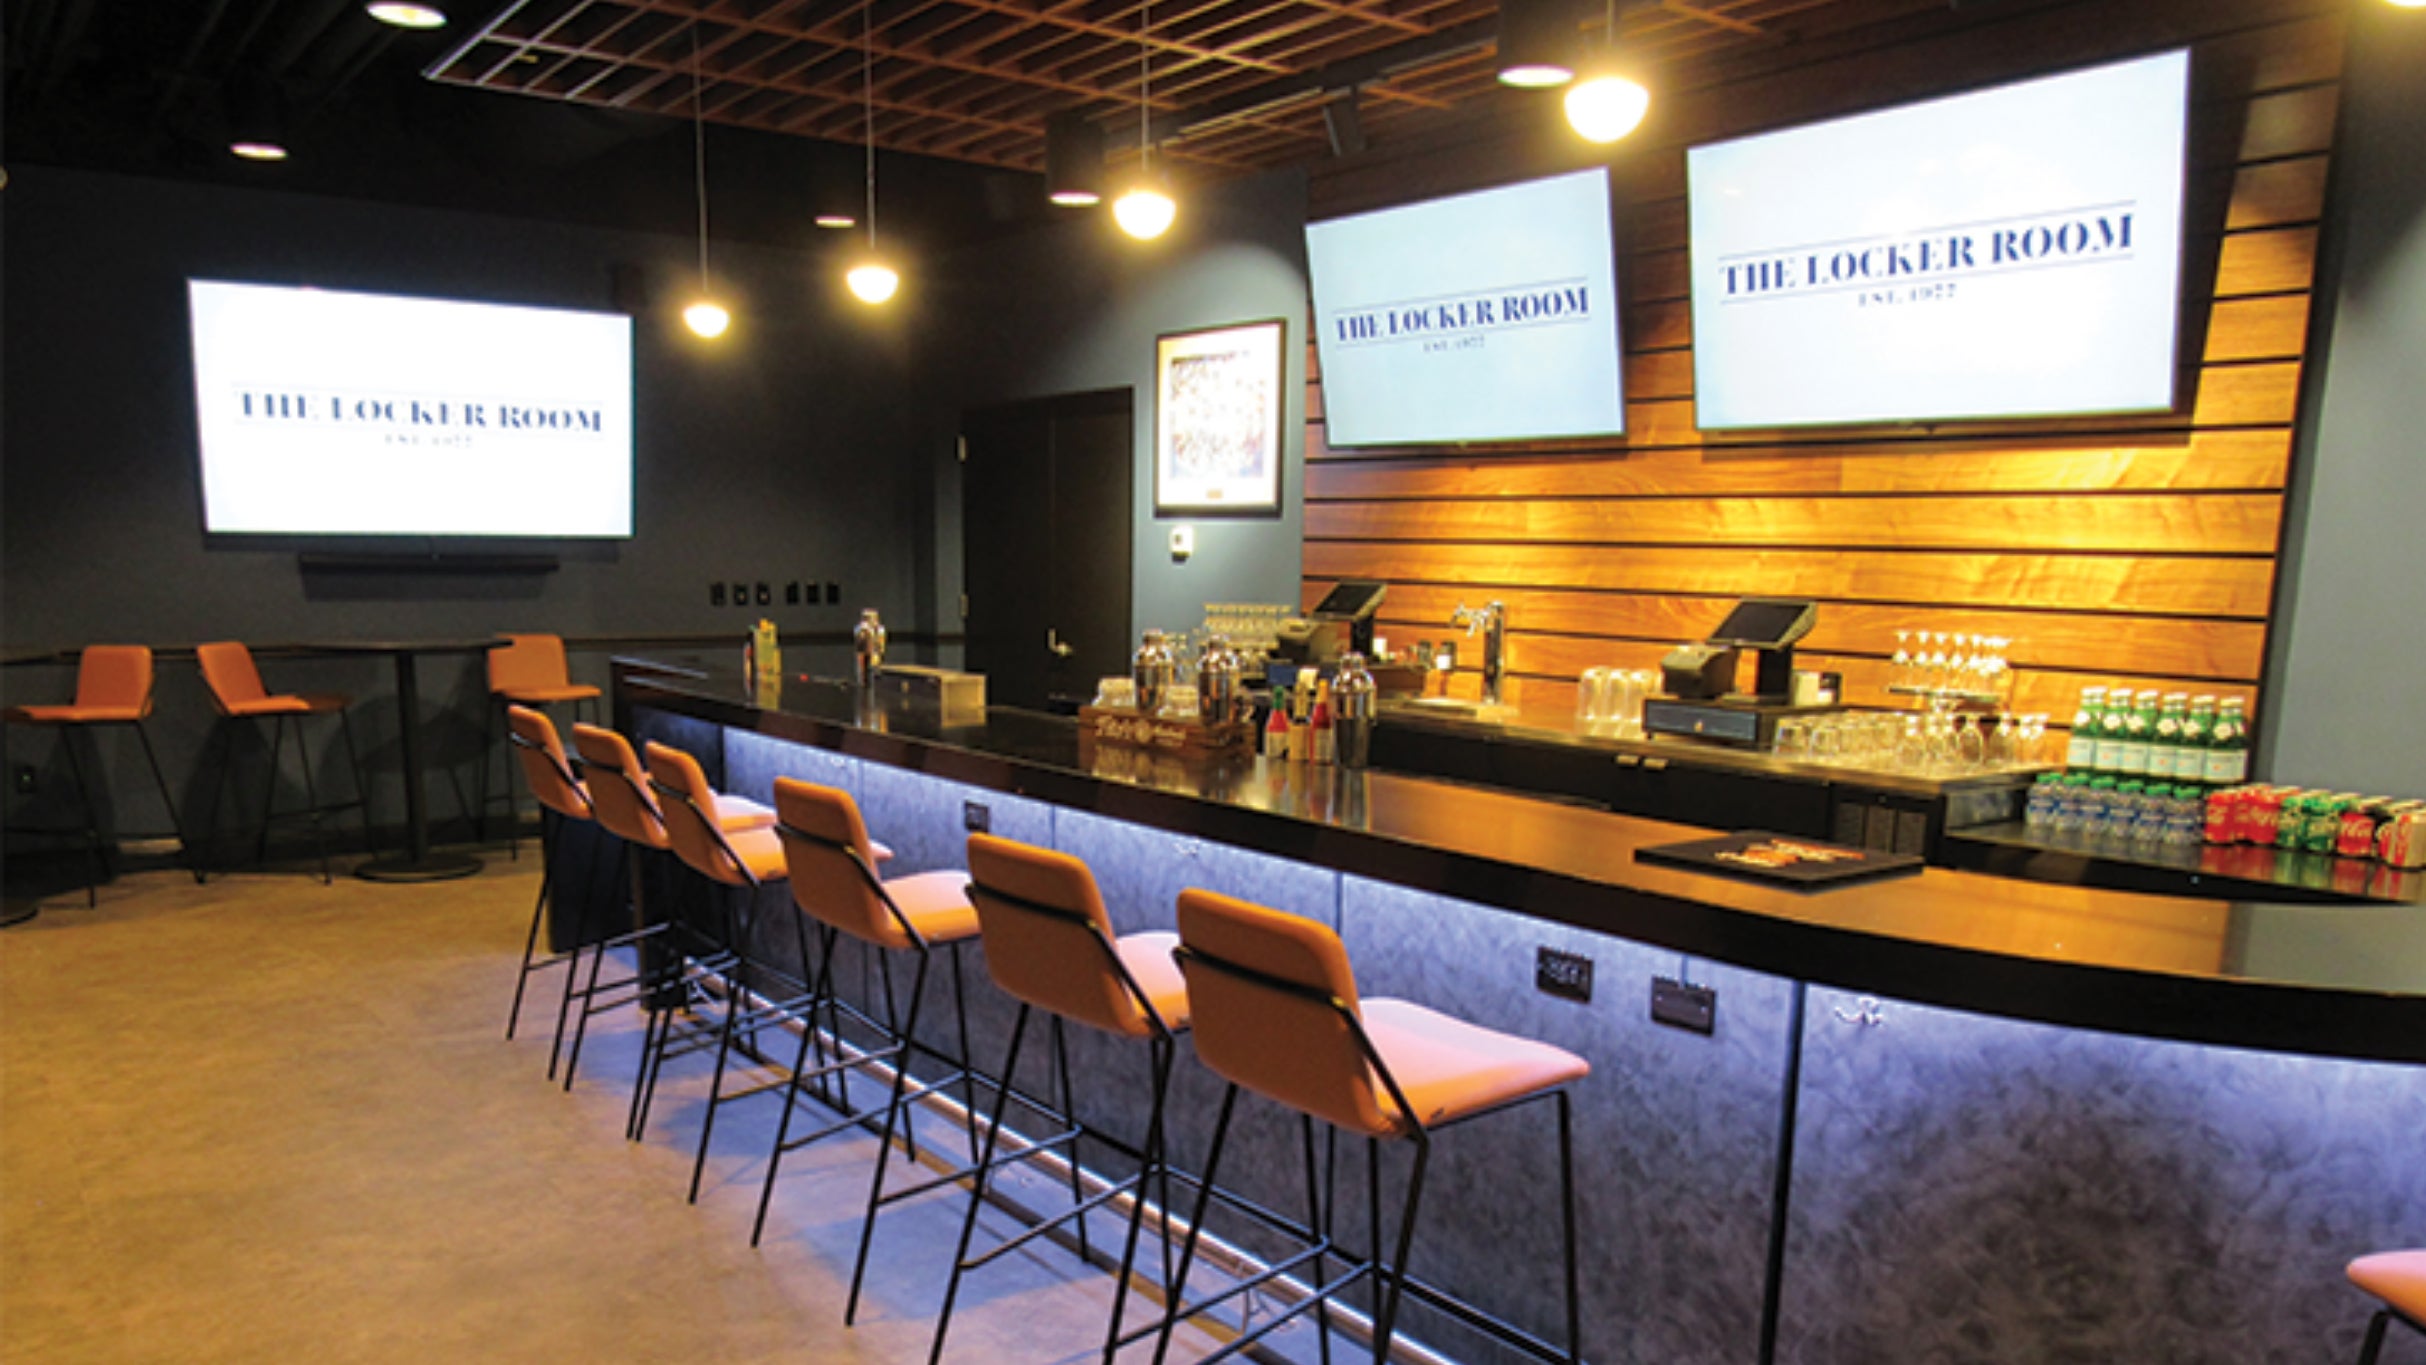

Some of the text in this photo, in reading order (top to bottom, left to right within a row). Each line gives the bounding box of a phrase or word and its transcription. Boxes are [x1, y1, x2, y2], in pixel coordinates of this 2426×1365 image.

[1719, 212, 2134, 295] THE LOCKER ROOM
[1335, 286, 1589, 341] THE LOCKER ROOM
[233, 391, 602, 432] THE LOCKER ROOM
